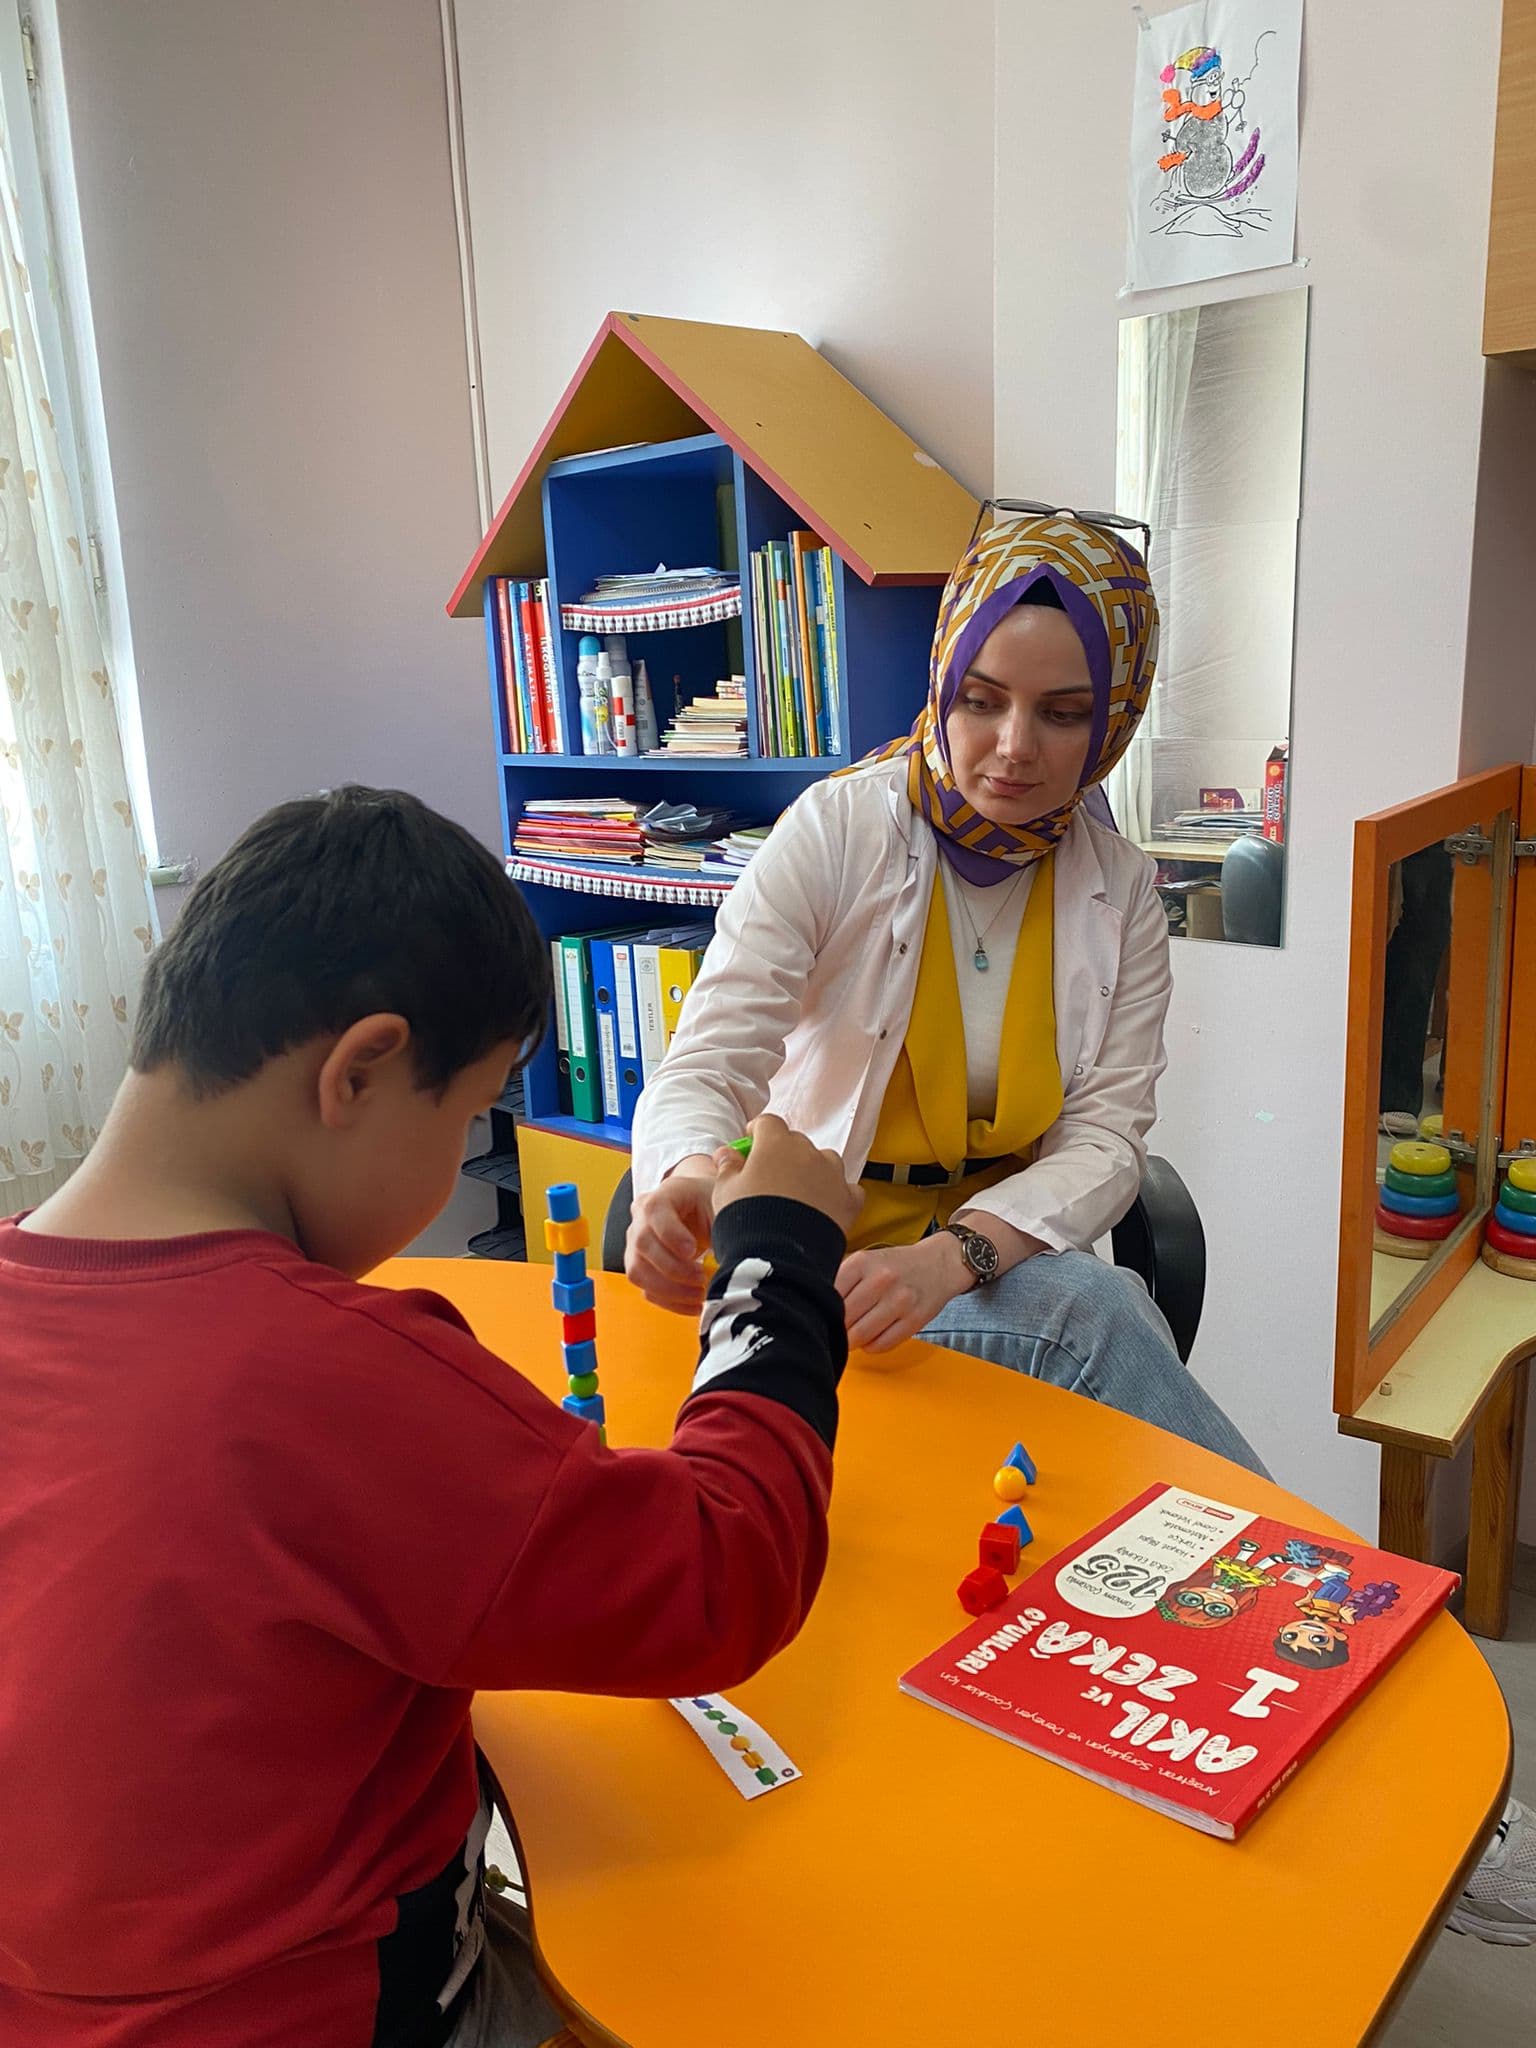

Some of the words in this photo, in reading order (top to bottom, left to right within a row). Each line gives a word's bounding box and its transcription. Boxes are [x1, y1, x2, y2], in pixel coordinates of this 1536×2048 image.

[1159, 1508, 1190, 1522] Yetenek
[1163, 1520, 1208, 1542] Matematik
[1191, 1520, 1218, 1533] Genel
[1161, 1543, 1189, 1559] Hayat
[1167, 1534, 1197, 1549] Türkçe
[1117, 1546, 1149, 1564] Etkinliği
[1066, 1575, 1103, 1596] Çözümlü
[1073, 1554, 1166, 1599] 125
[1103, 1591, 1138, 1611] Tamamı
[955, 1607, 1047, 1675] OYUNLARI
[1030, 1621, 1199, 1702] ZEKÂ
[961, 1684, 1013, 1710] Çocuklar
[1080, 1686, 1113, 1707] VE
[1228, 1666, 1300, 1719] 1
[1015, 1707, 1065, 1736] Deneyen
[1067, 1732, 1081, 1742] ve
[1109, 1701, 1258, 1773] AKIL
[1085, 1739, 1153, 1771] Sorgulayan
